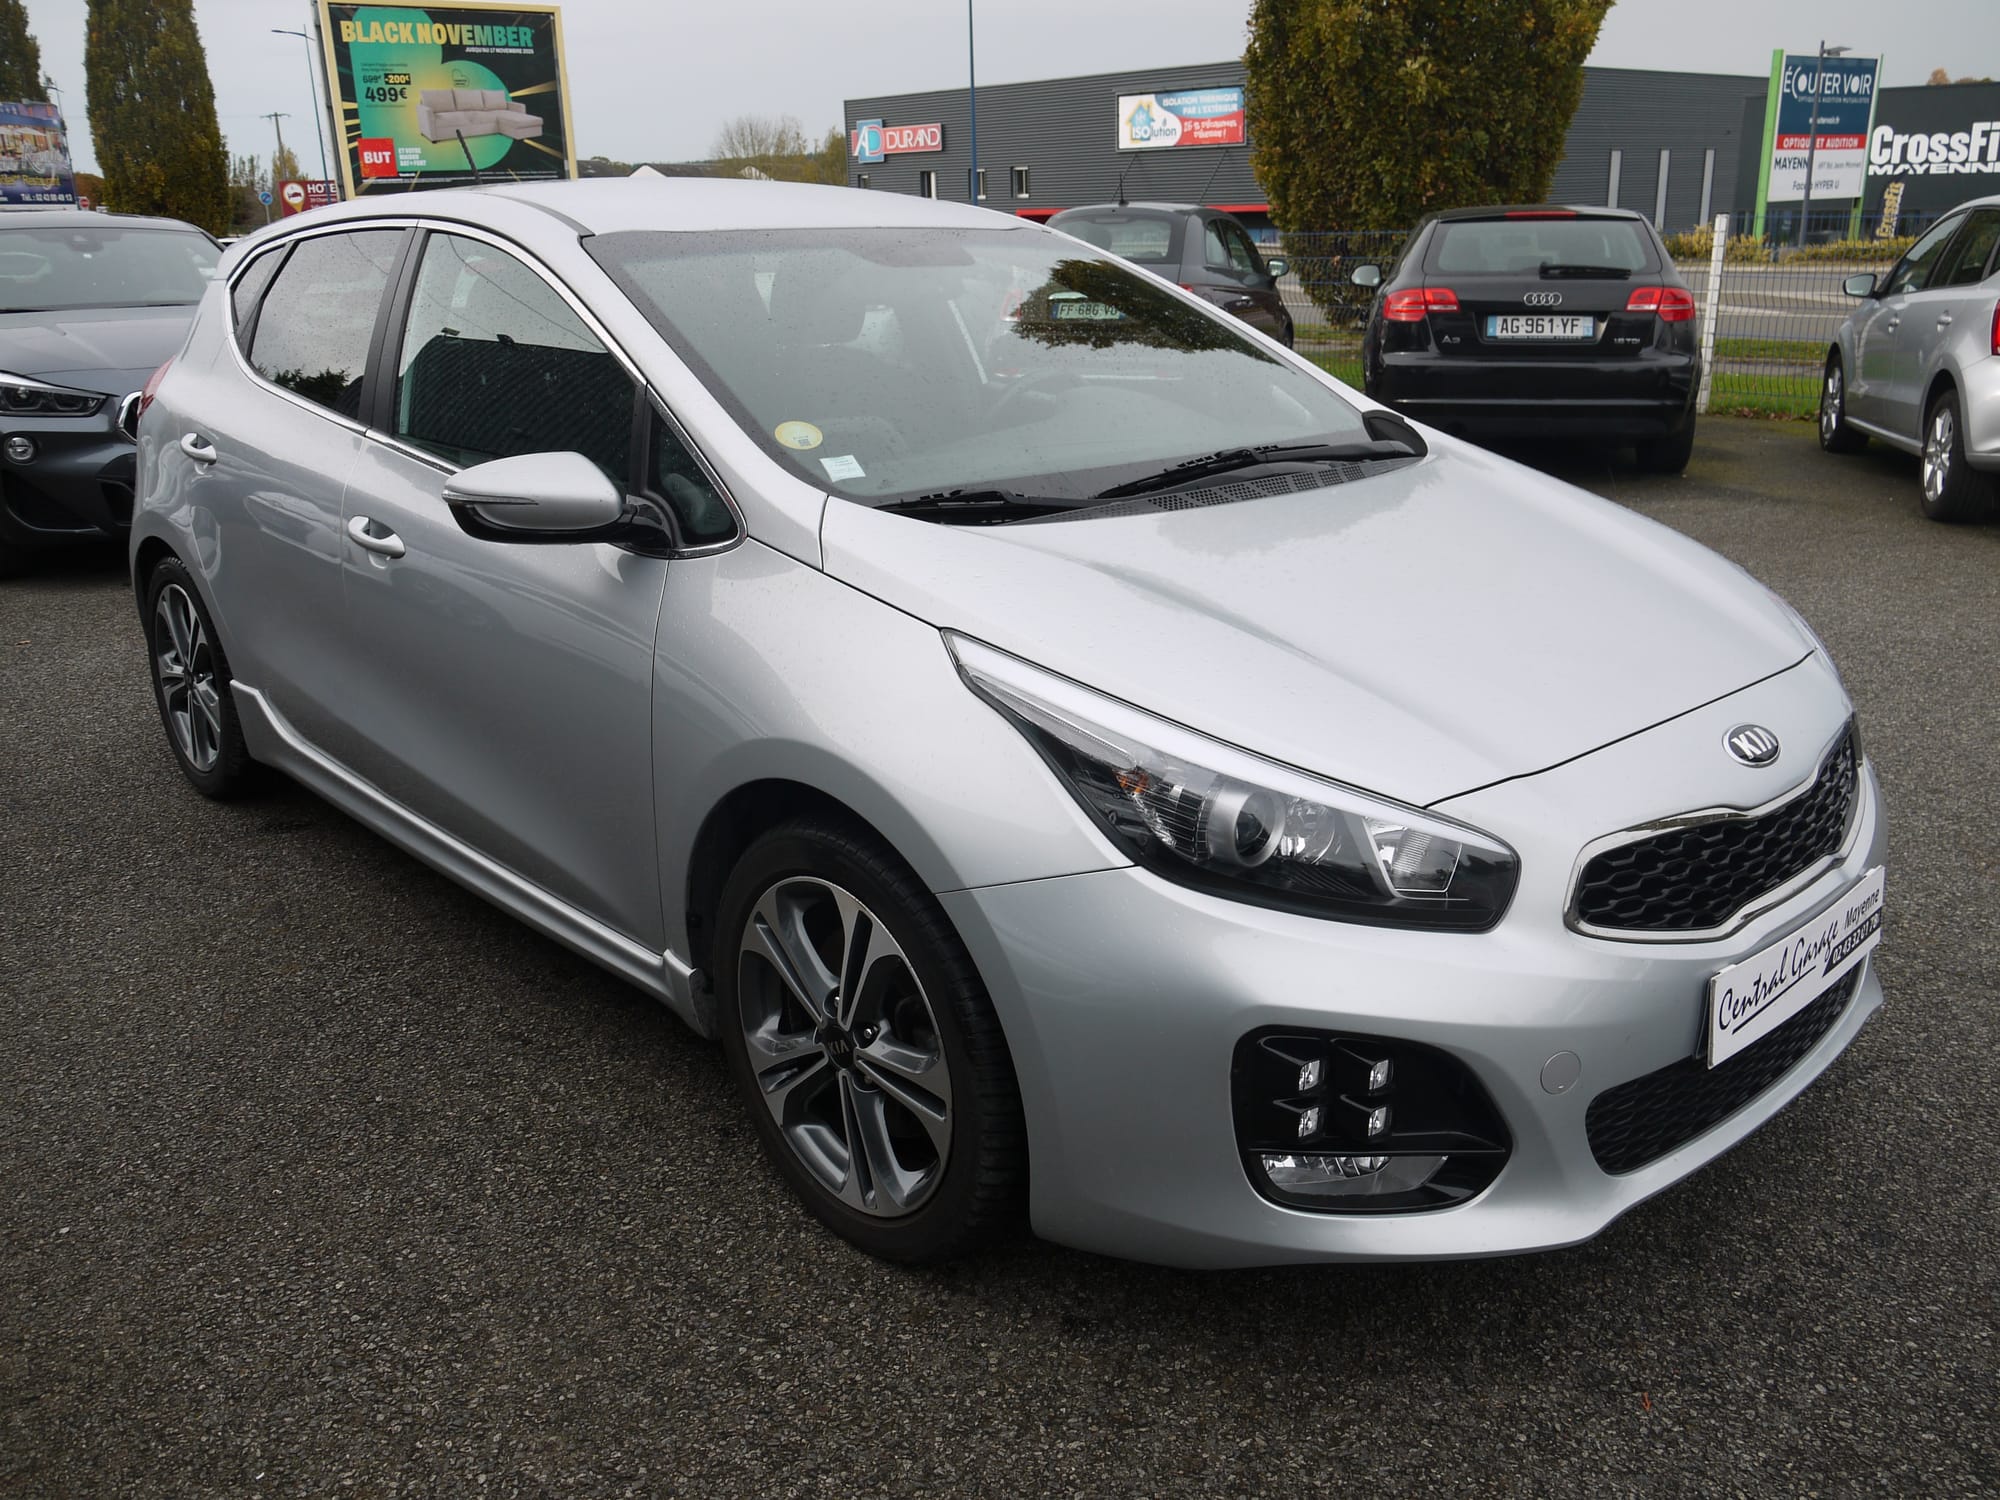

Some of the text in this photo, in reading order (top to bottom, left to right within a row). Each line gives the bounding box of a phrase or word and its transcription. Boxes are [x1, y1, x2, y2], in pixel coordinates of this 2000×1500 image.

[340, 20, 533, 47] BLACK NOVEMBER
[1843, 74, 1872, 95] VOIR
[365, 87, 408, 103] 499€
[886, 128, 940, 149] DURAND
[1783, 138, 1859, 148] OPTIQU ET AUDITION
[363, 151, 391, 164] BUT
[1774, 157, 1809, 170] MAYENN
[1719, 888, 1880, 1030] Central Garage Mayenne
[827, 1039, 850, 1055] KIA
